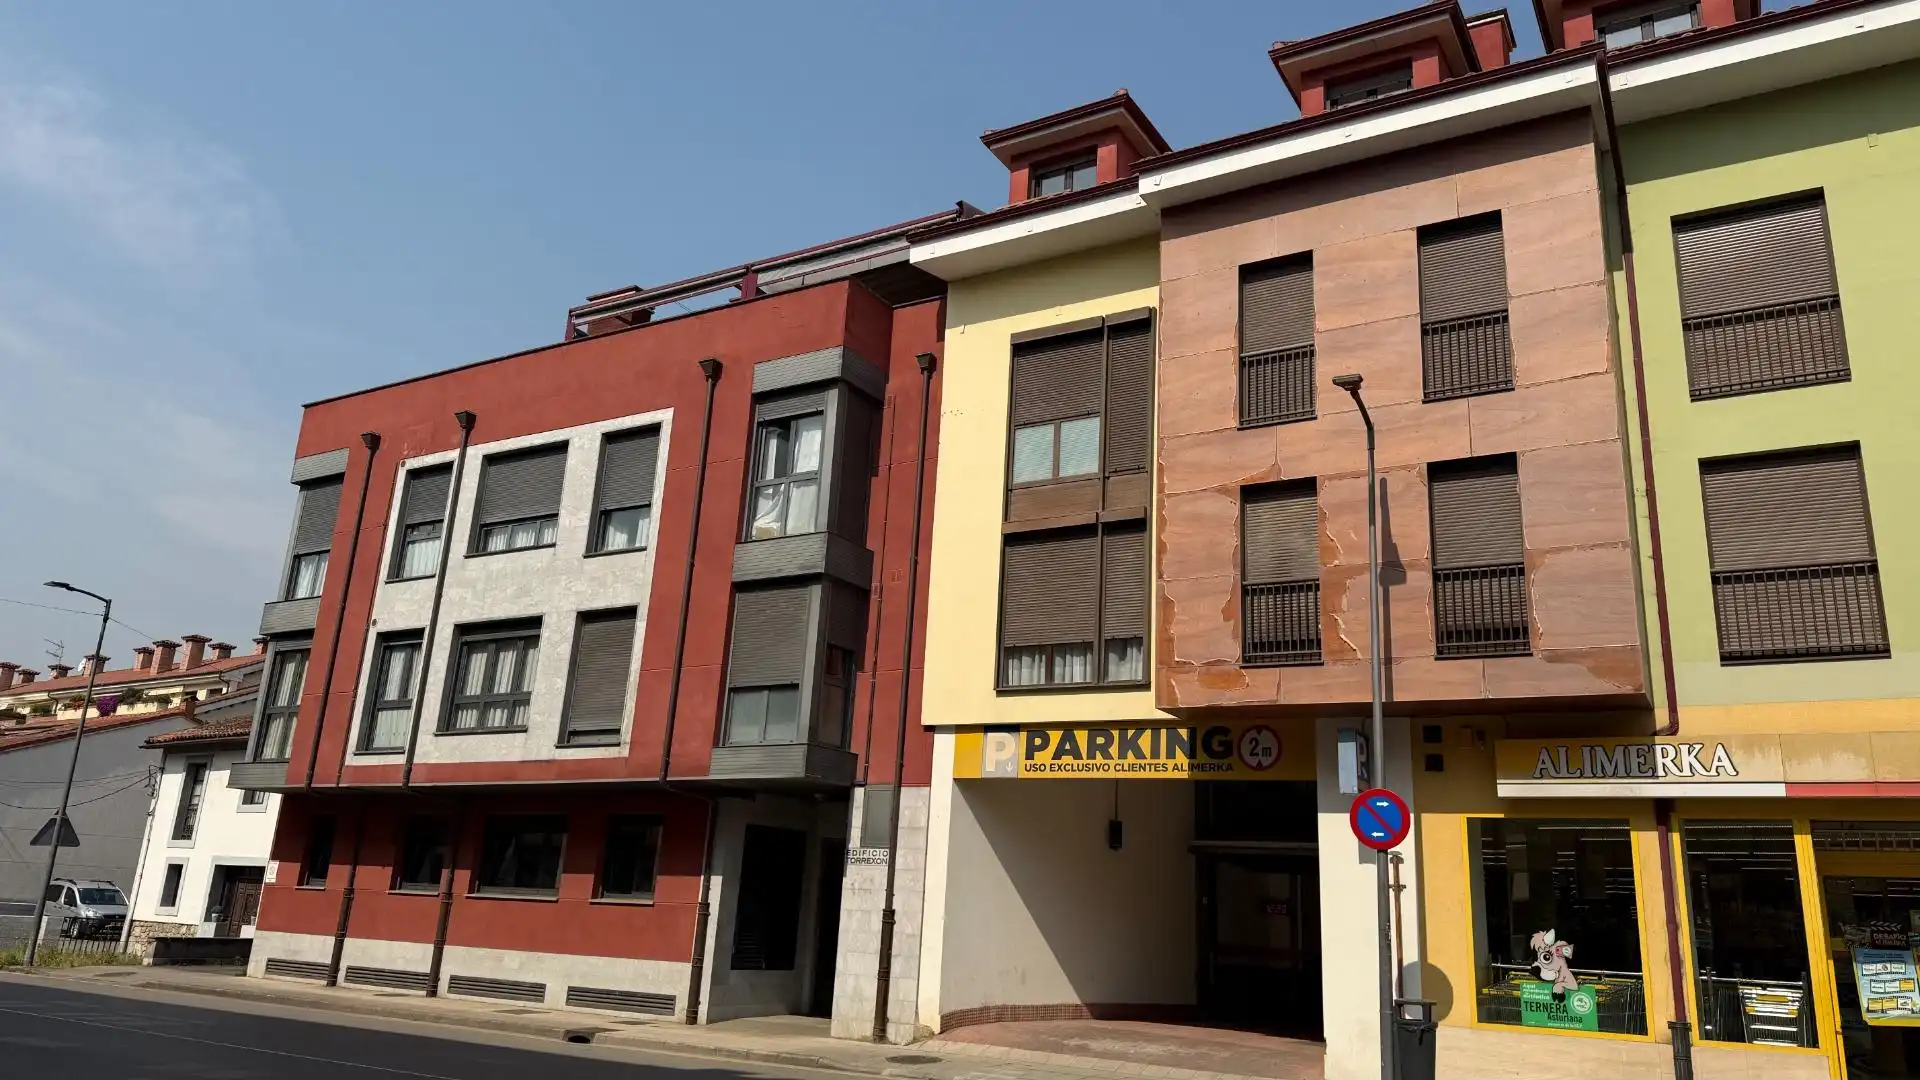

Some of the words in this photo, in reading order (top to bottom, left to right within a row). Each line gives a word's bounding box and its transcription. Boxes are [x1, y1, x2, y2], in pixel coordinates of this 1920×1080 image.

[1025, 726, 1234, 760] PARKING
[985, 732, 1016, 772] P
[1533, 743, 1739, 779] ALIMERKA
[1024, 763, 1047, 772] USO
[1049, 763, 1111, 772] EXCLUSIVO
[1113, 763, 1169, 772] CLIENTES
[1171, 763, 1234, 772] ALIMERKA
[847, 849, 888, 857] EDIFICIO
[846, 857, 888, 865] TORREXON
[1523, 1001, 1569, 1015] TERNERA
[1547, 1012, 1583, 1023] Asturiana
